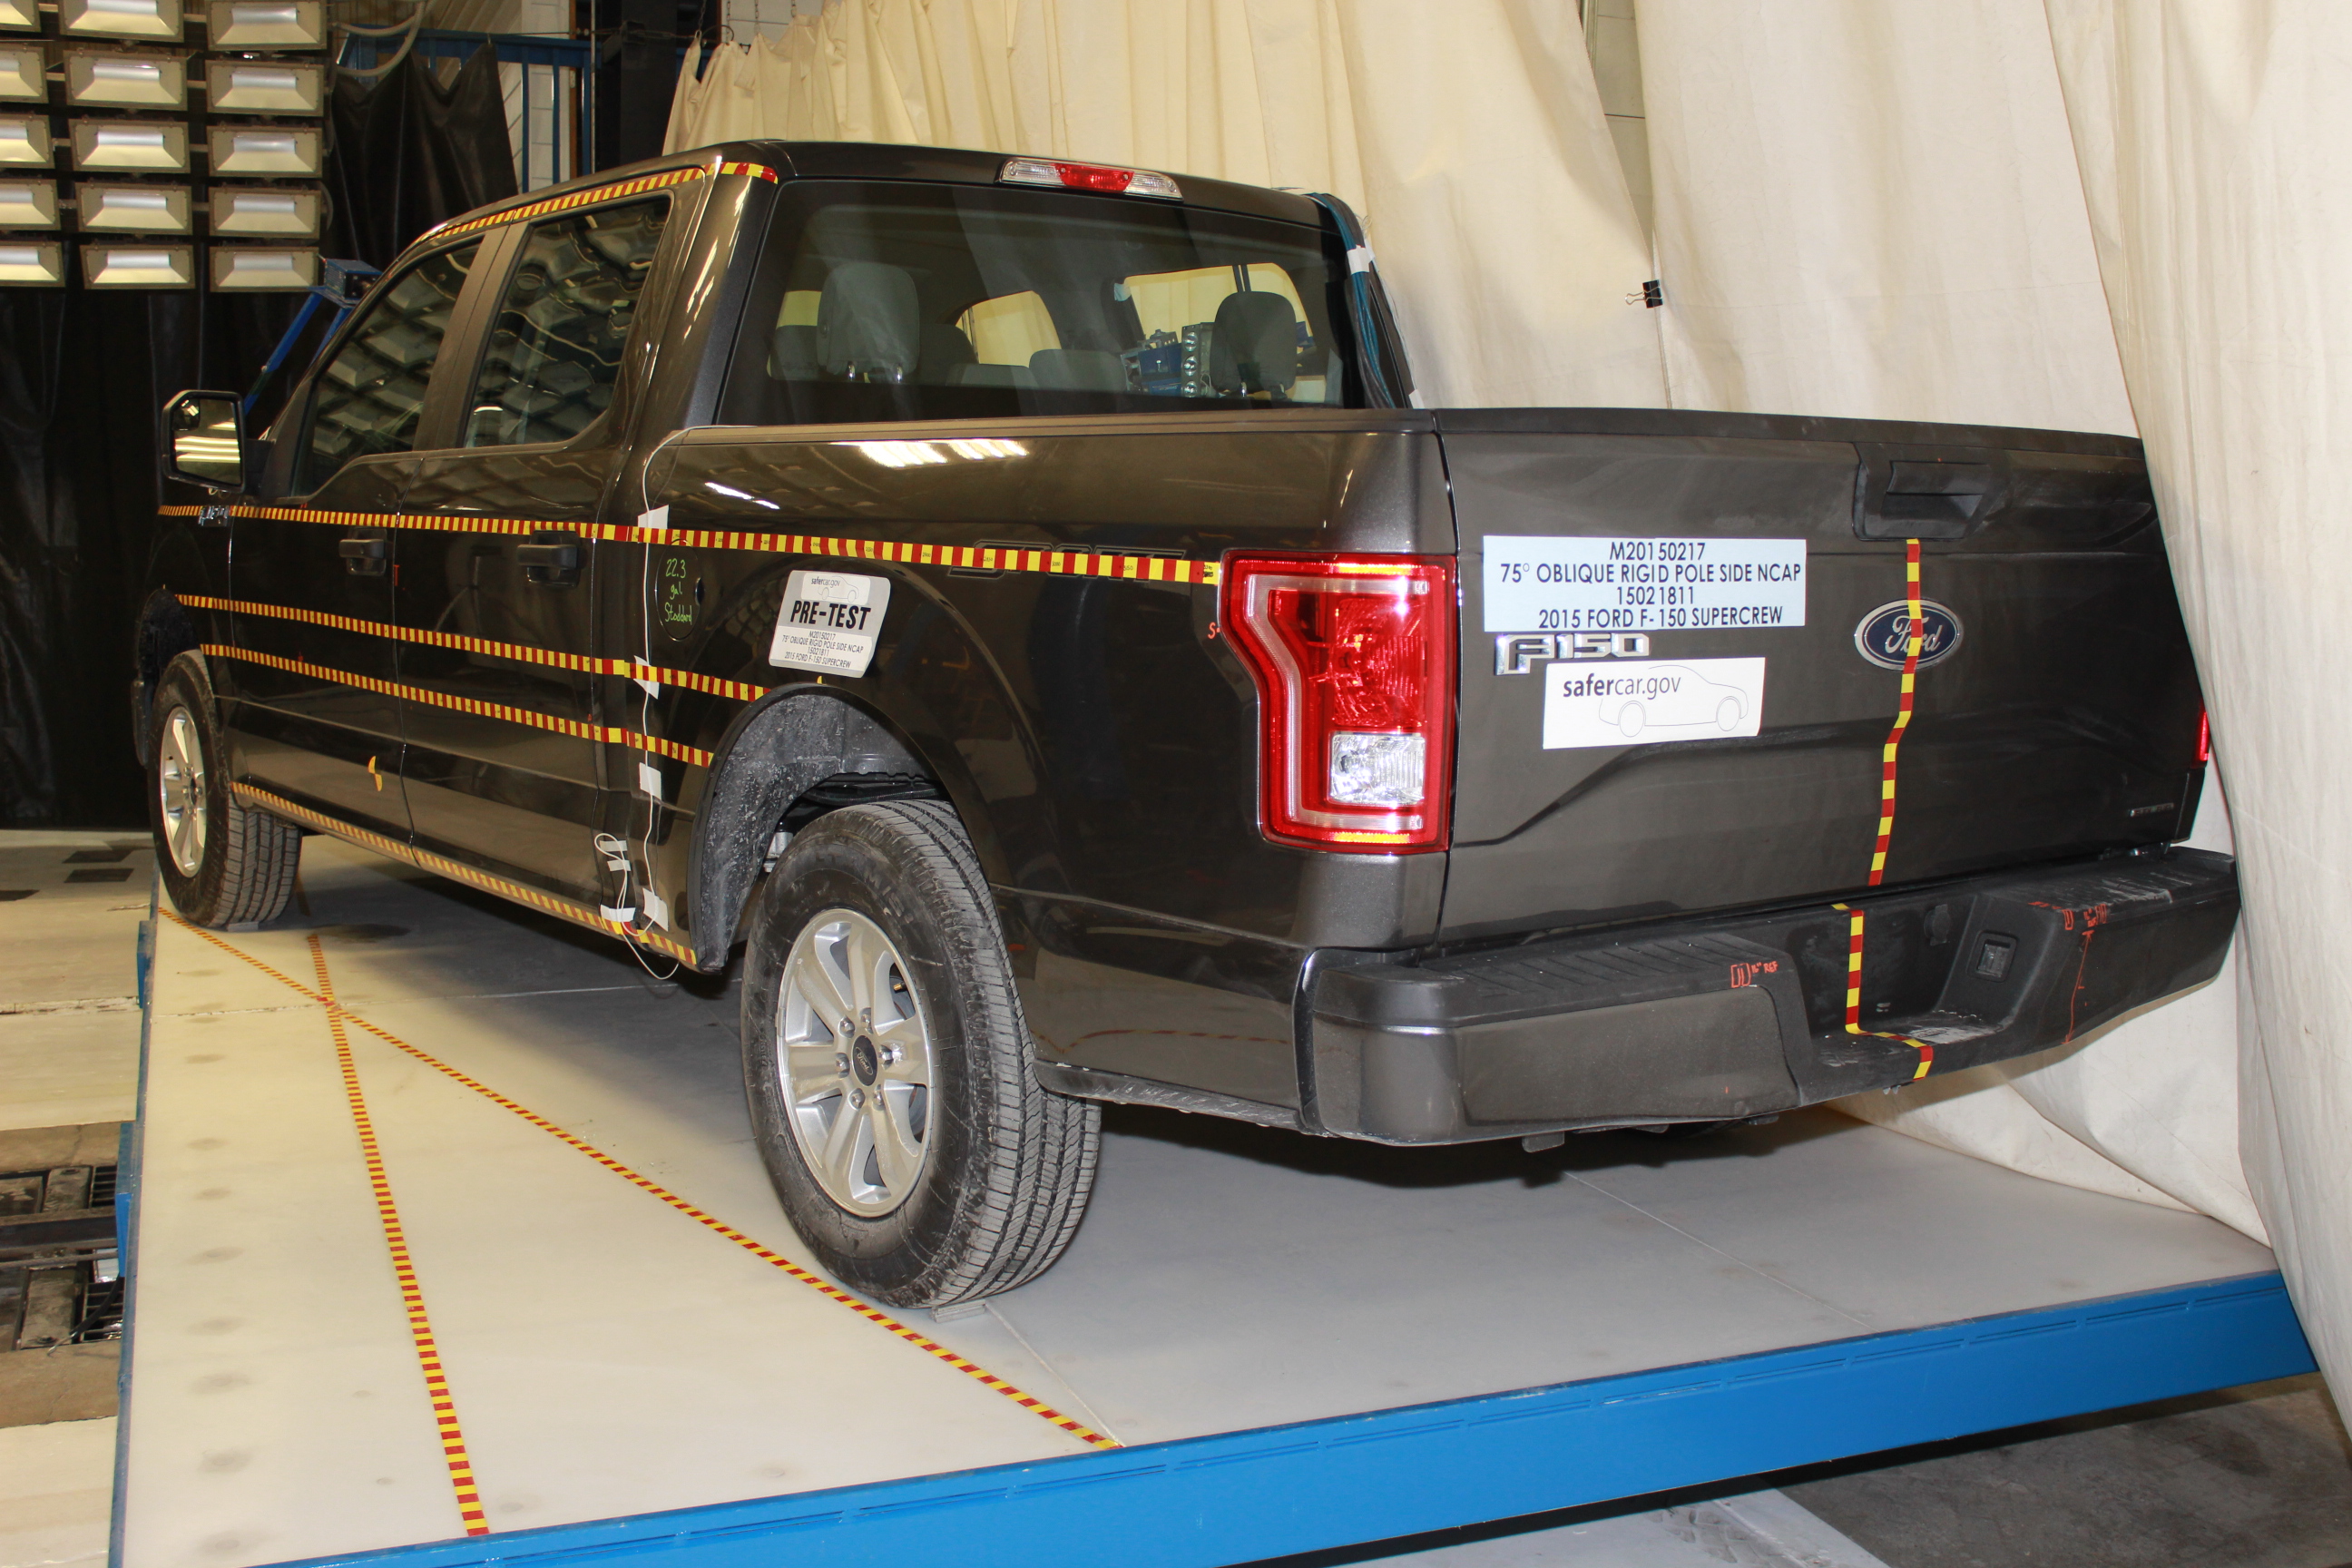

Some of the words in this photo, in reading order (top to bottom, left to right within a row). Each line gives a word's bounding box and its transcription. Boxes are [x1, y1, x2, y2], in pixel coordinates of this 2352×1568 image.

[1610, 542, 1706, 561] M20150217
[665, 558, 686, 578] 22.3
[1500, 563, 1530, 583] 75°
[1536, 564, 1614, 583] OBLIQUE
[1621, 564, 1670, 583] RIGID
[1675, 564, 1714, 583] POLE
[1720, 564, 1752, 582] SIDE
[1758, 564, 1801, 582] NCAP
[670, 582, 682, 600] gal
[811, 576, 840, 588] safercar.gov
[1617, 586, 1694, 605] 15021811
[790, 601, 871, 630] PRE-TEST
[1539, 609, 1581, 629] 2015
[1588, 609, 1633, 628] FORD
[1641, 608, 1686, 628] F-150
[1691, 606, 1783, 626] SUPERCREW
[790, 636, 808, 645] OBLIQUE
[809, 639, 823, 647] RIGID
[824, 641, 836, 649] POLE
[836, 642, 847, 652] SIDE
[848, 645, 864, 653] NCAP
[808, 631, 836, 641] M20150217
[785, 652, 795, 660] 2015
[796, 652, 808, 662] FORD
[822, 657, 851, 668] SUPERCREW
[1563, 672, 1681, 700] safercar.gov
